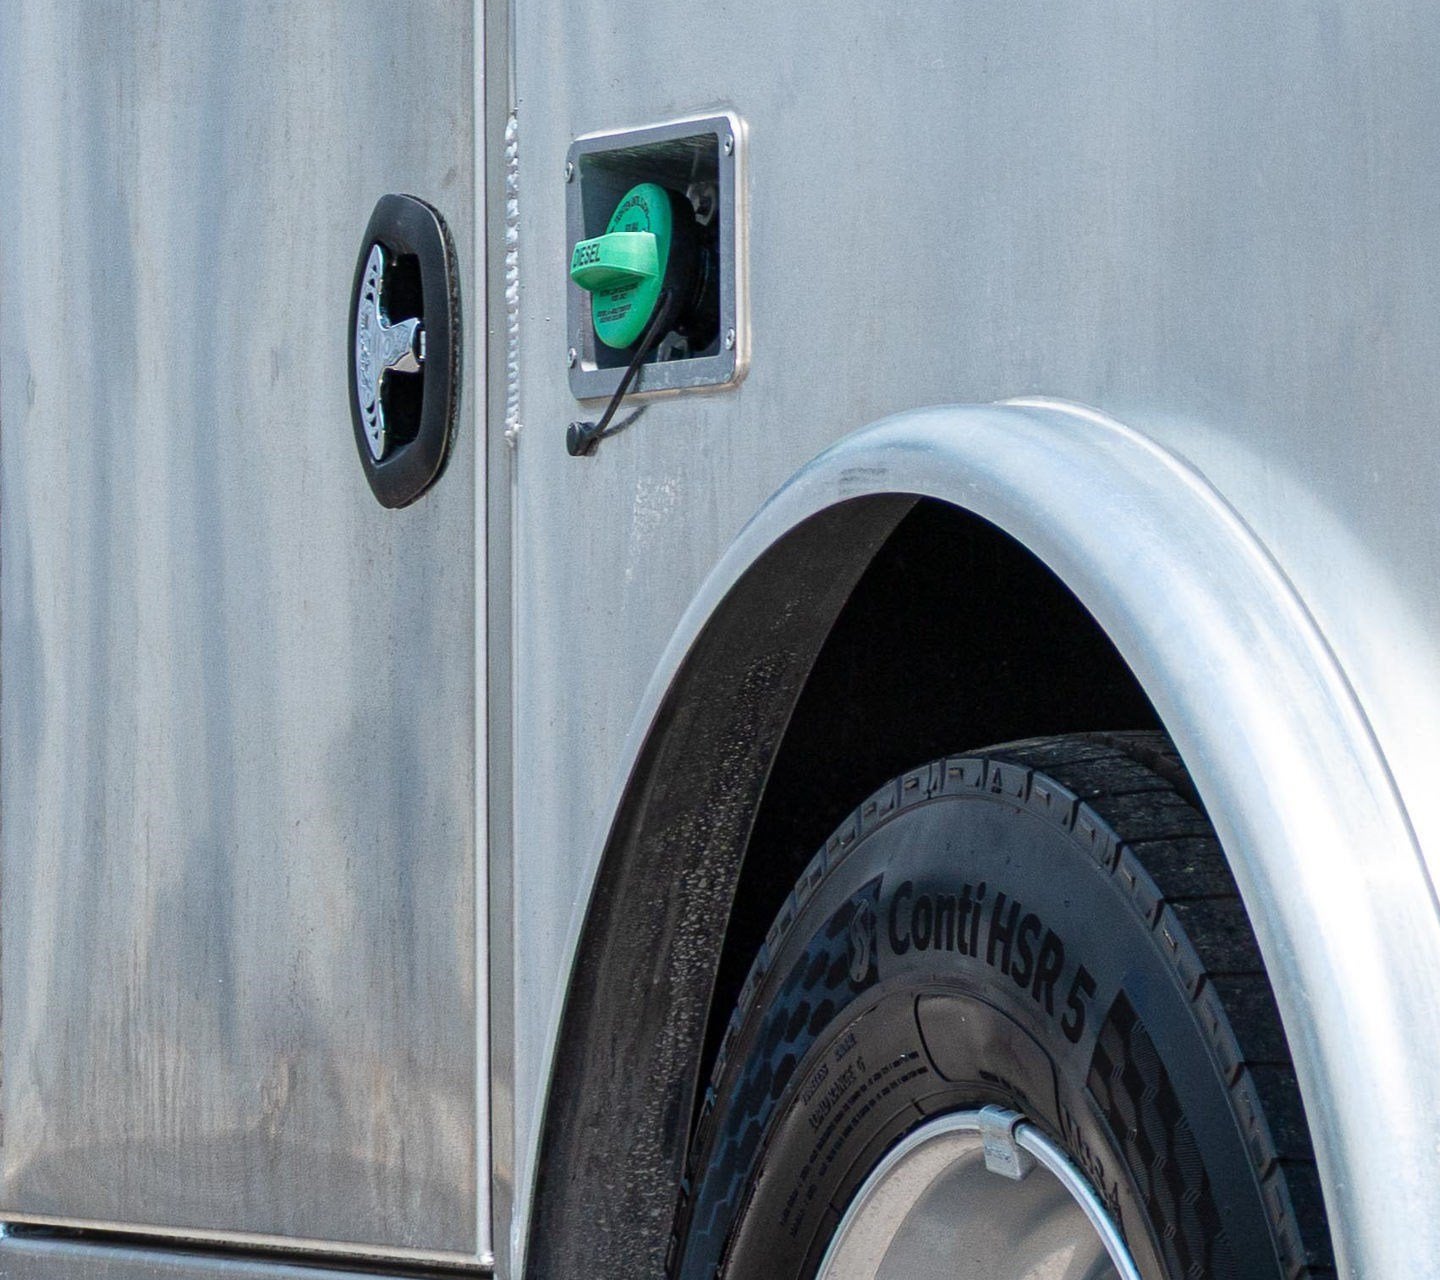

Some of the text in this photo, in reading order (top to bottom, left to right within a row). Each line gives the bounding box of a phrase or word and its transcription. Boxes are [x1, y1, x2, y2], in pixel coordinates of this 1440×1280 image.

[572, 242, 600, 268] DIESEL
[887, 879, 1098, 1045] Conti HSR 5
